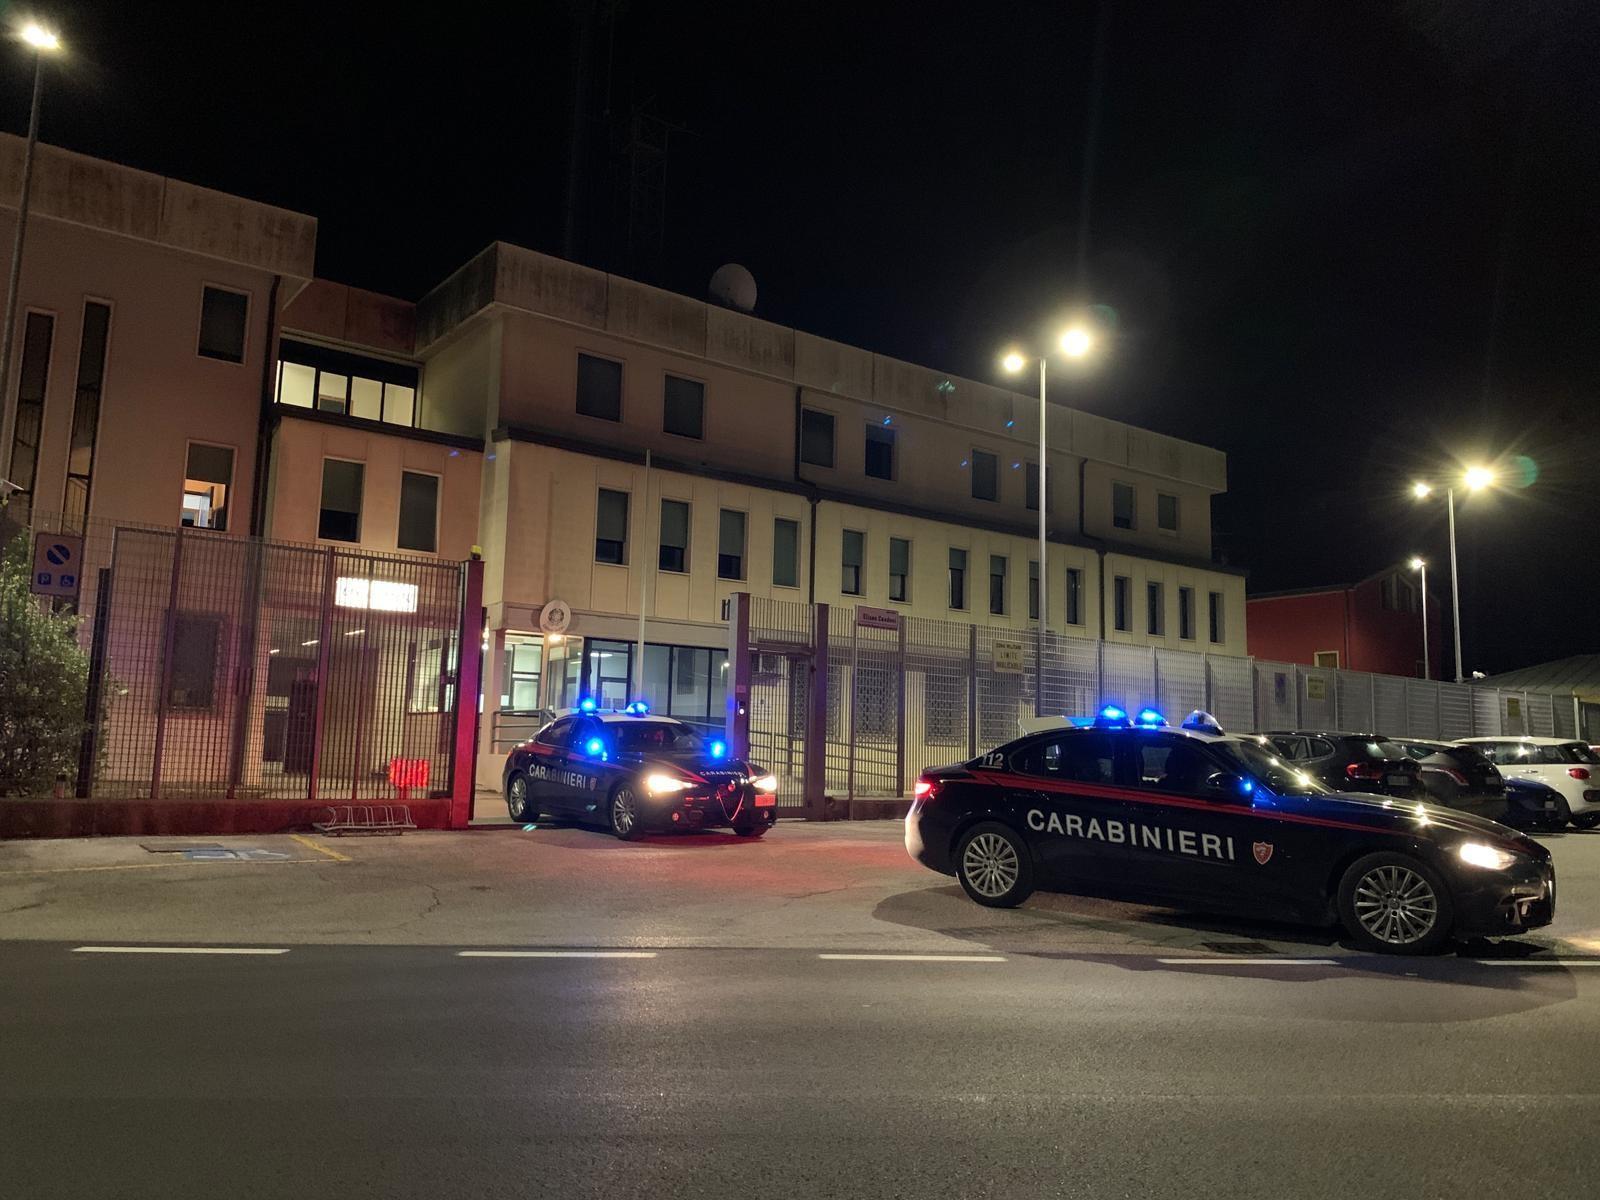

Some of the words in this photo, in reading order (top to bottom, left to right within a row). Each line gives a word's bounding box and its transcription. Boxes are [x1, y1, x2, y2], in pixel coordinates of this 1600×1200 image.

[982, 752, 1004, 767] 112
[529, 763, 586, 789] CARABINIERI
[1027, 809, 1235, 860] CARABINIERI
